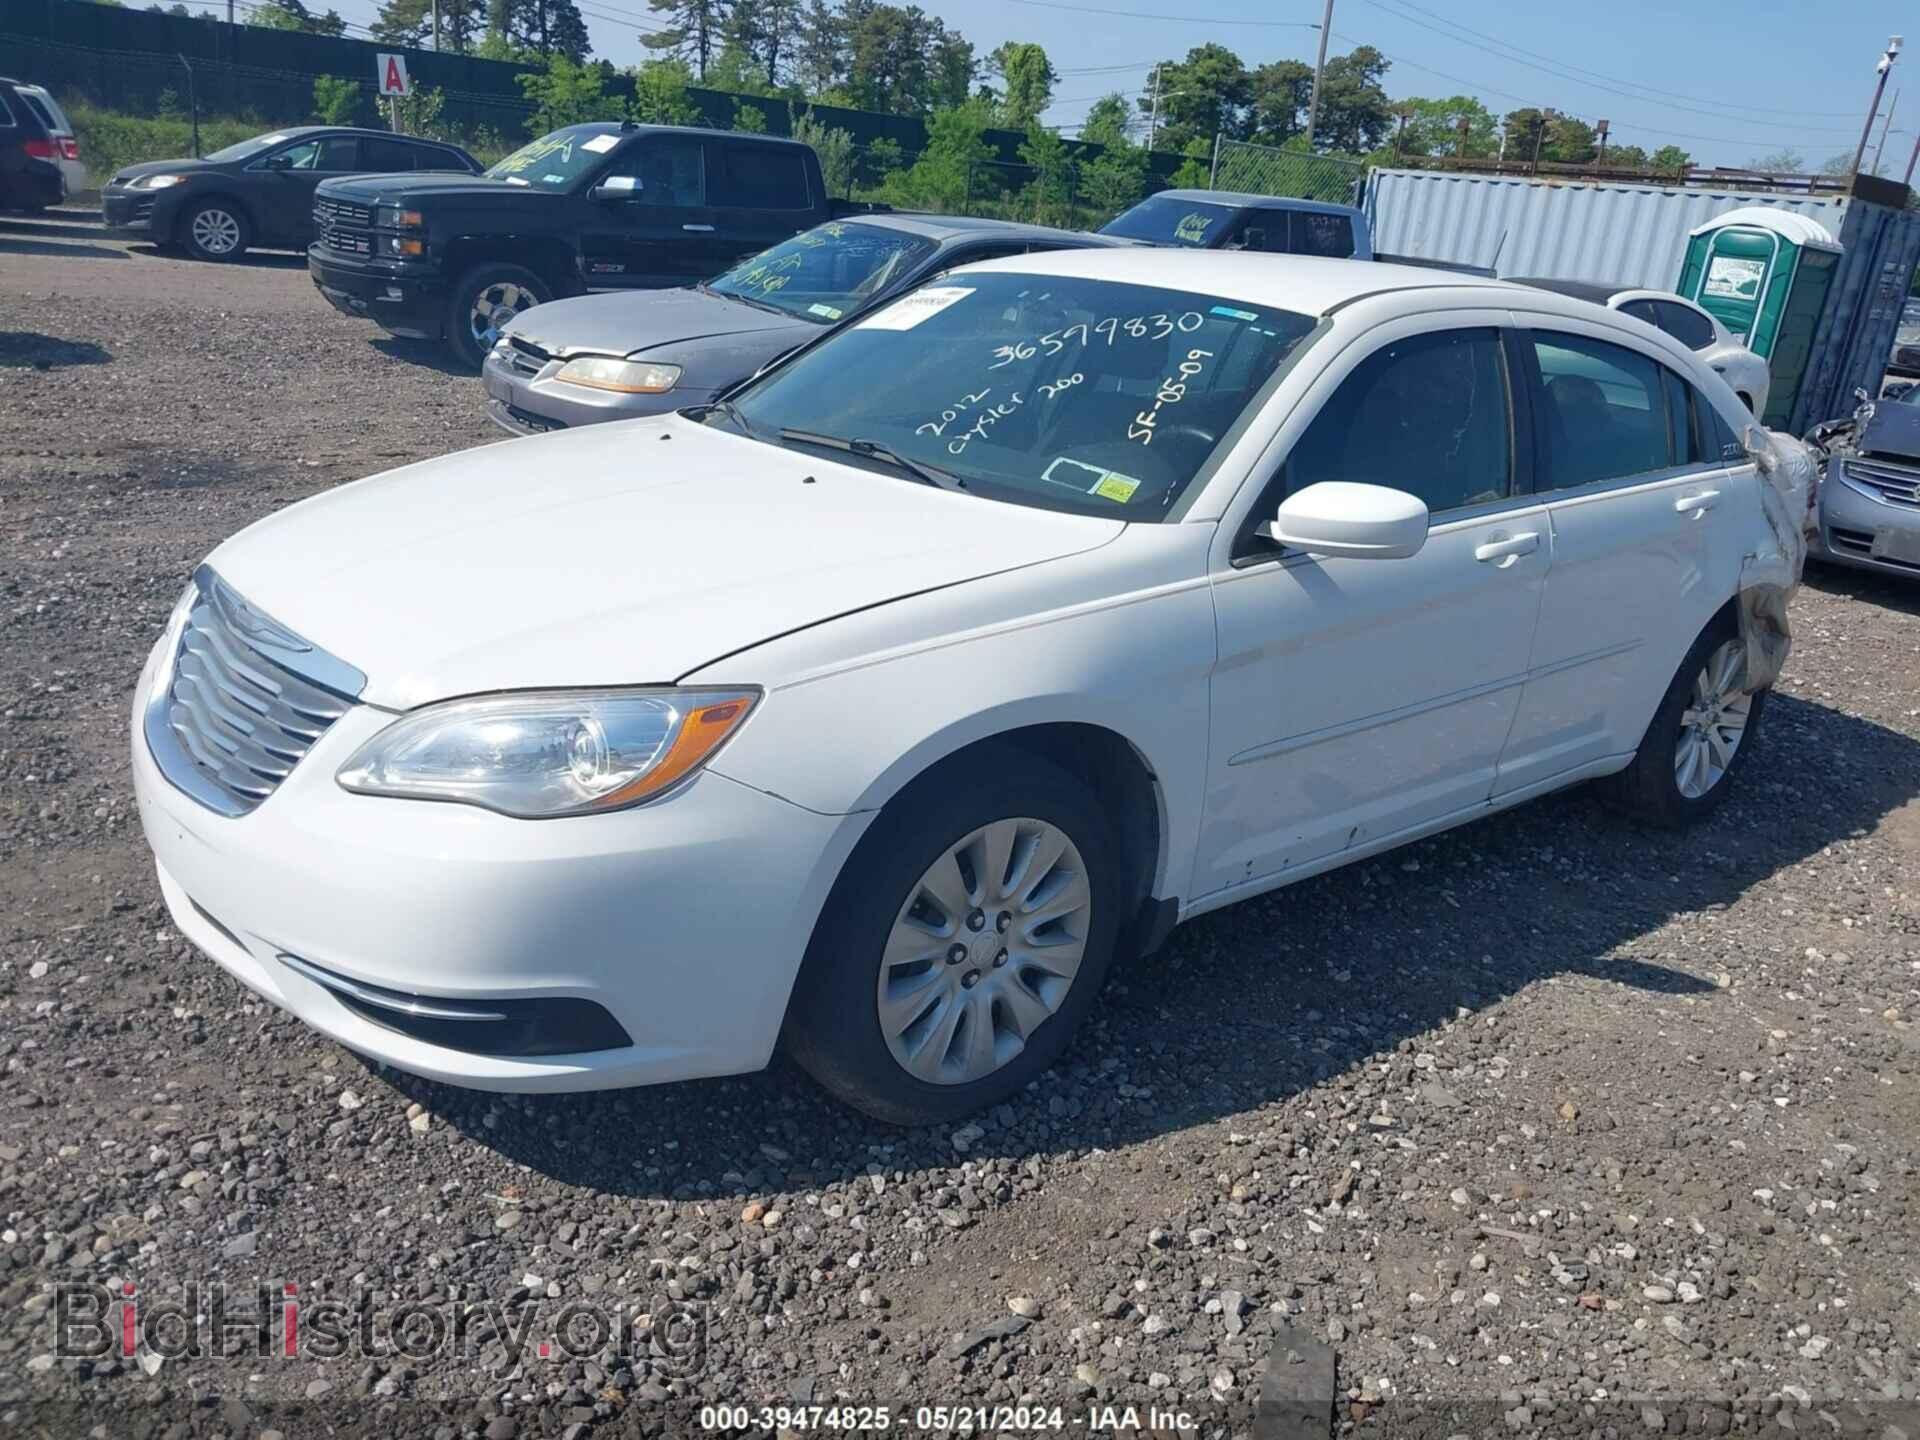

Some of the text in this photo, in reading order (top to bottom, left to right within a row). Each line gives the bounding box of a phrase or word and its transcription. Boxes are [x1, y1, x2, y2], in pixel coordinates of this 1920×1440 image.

[386, 55, 404, 92] A
[988, 311, 1204, 370] 36599830
[1037, 373, 1084, 399] 200
[1128, 349, 1214, 446] SF-05-09
[915, 387, 991, 437] 2012
